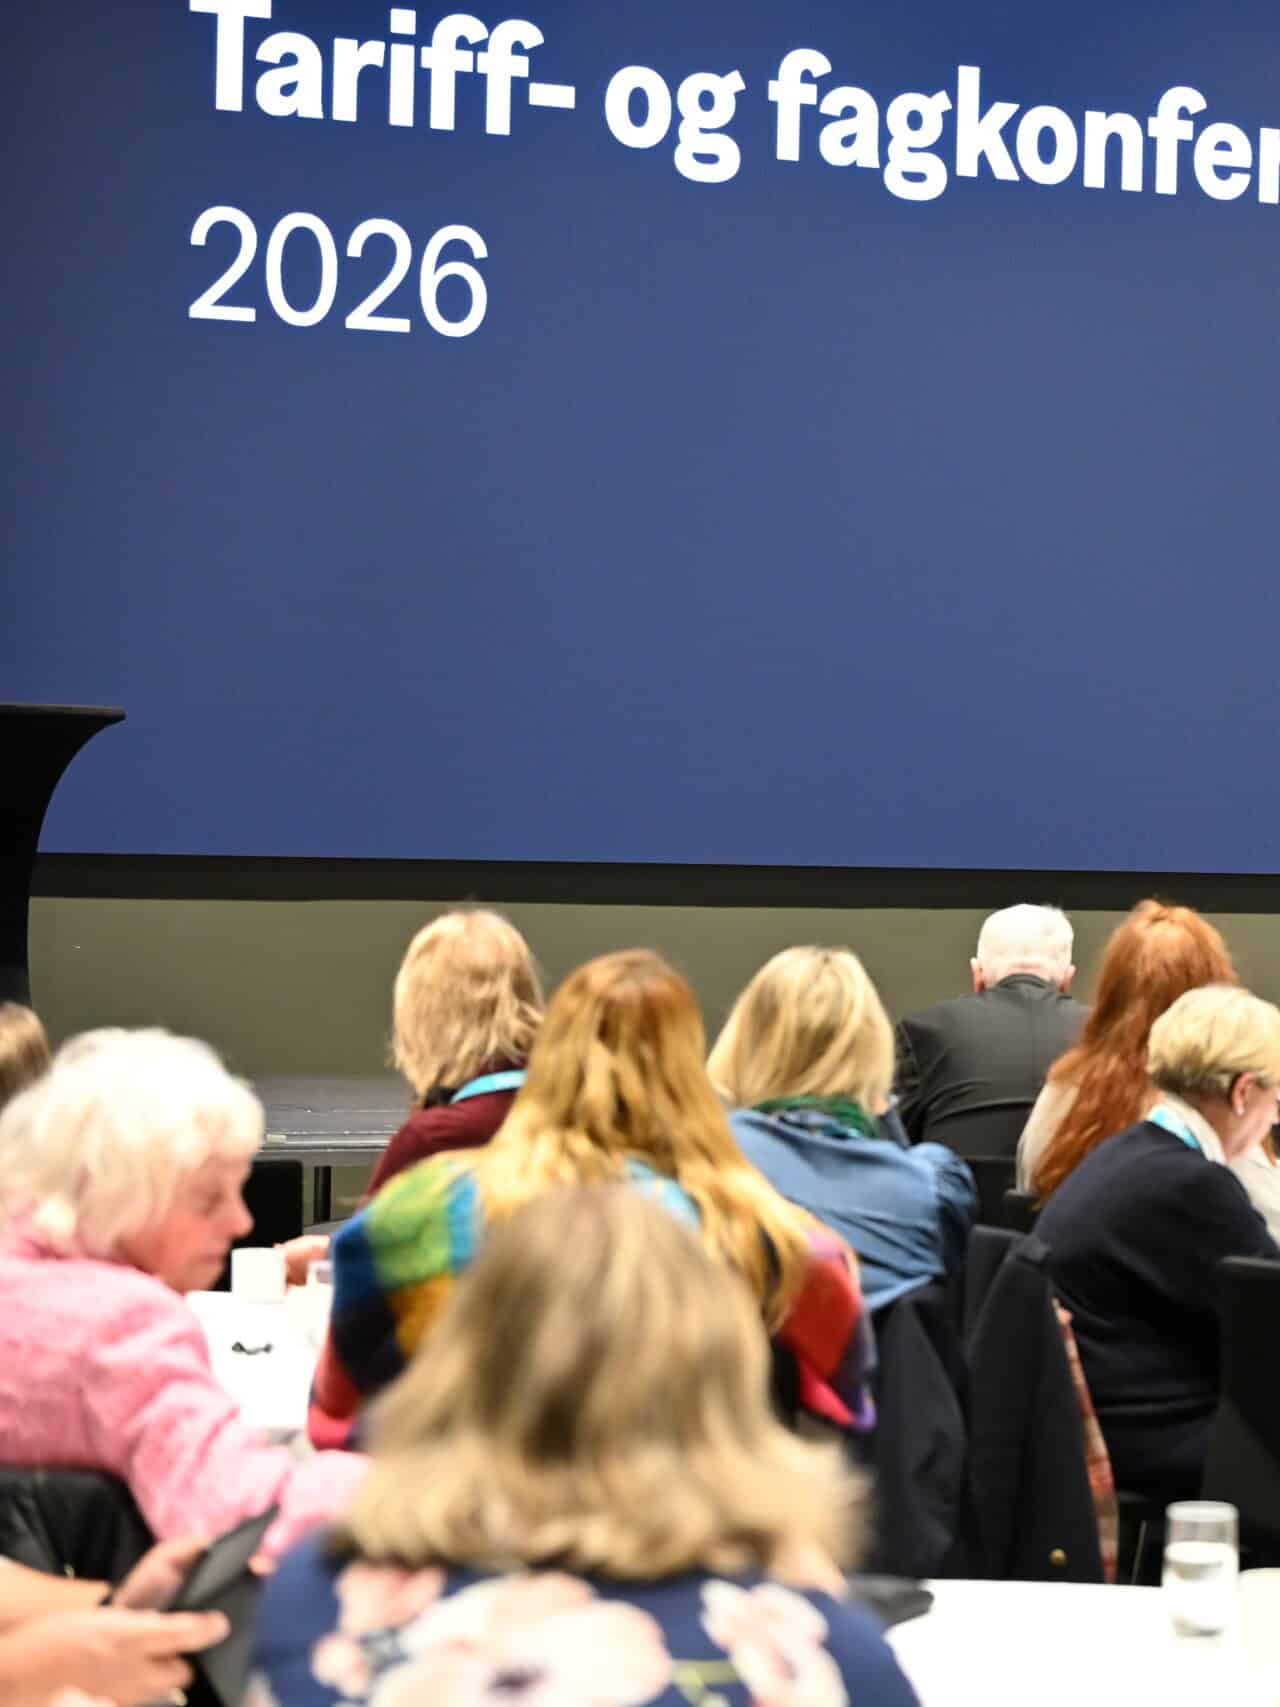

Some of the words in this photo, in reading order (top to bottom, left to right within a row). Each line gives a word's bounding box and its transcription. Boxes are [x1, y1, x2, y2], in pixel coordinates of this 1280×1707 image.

[190, 0, 576, 136] Tariff-
[604, 65, 746, 184] og
[188, 205, 489, 338] 2026
